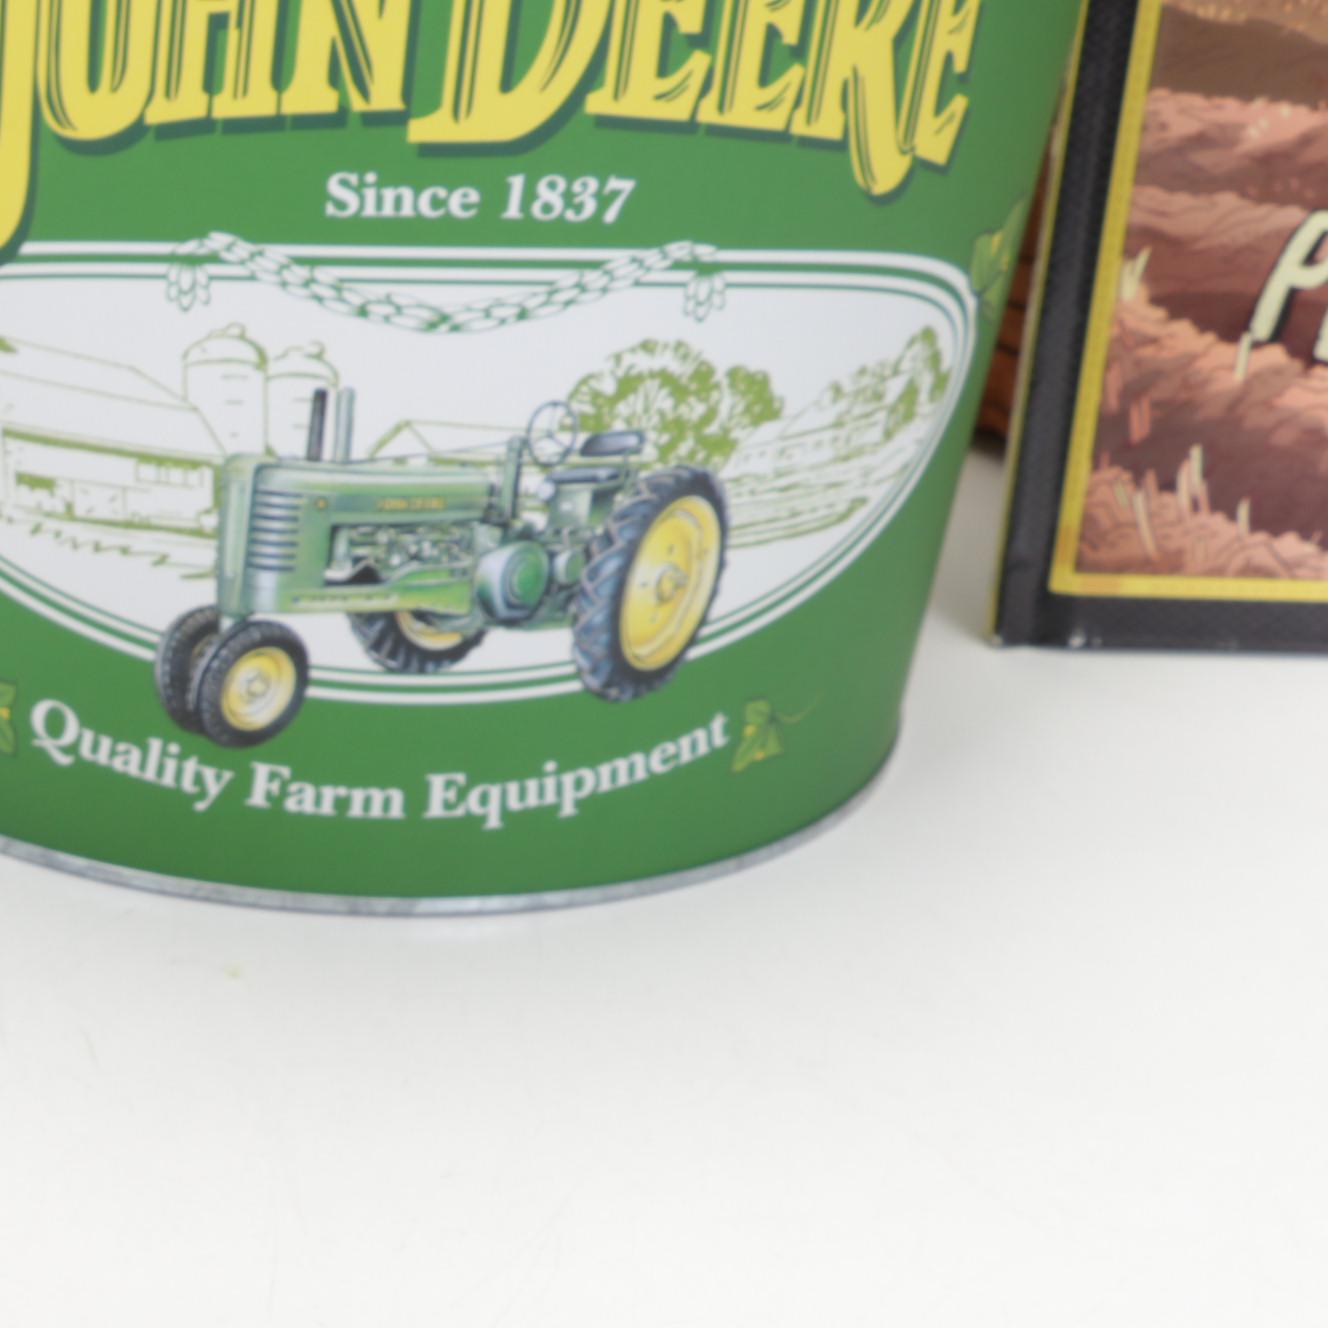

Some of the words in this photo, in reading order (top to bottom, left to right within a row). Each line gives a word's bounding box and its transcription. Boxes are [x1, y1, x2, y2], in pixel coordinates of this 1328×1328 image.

[324, 171, 482, 219] Since
[500, 174, 637, 224] 1837
[30, 699, 235, 812] Quality
[245, 760, 406, 820] Farm
[423, 712, 731, 829] Equipment
